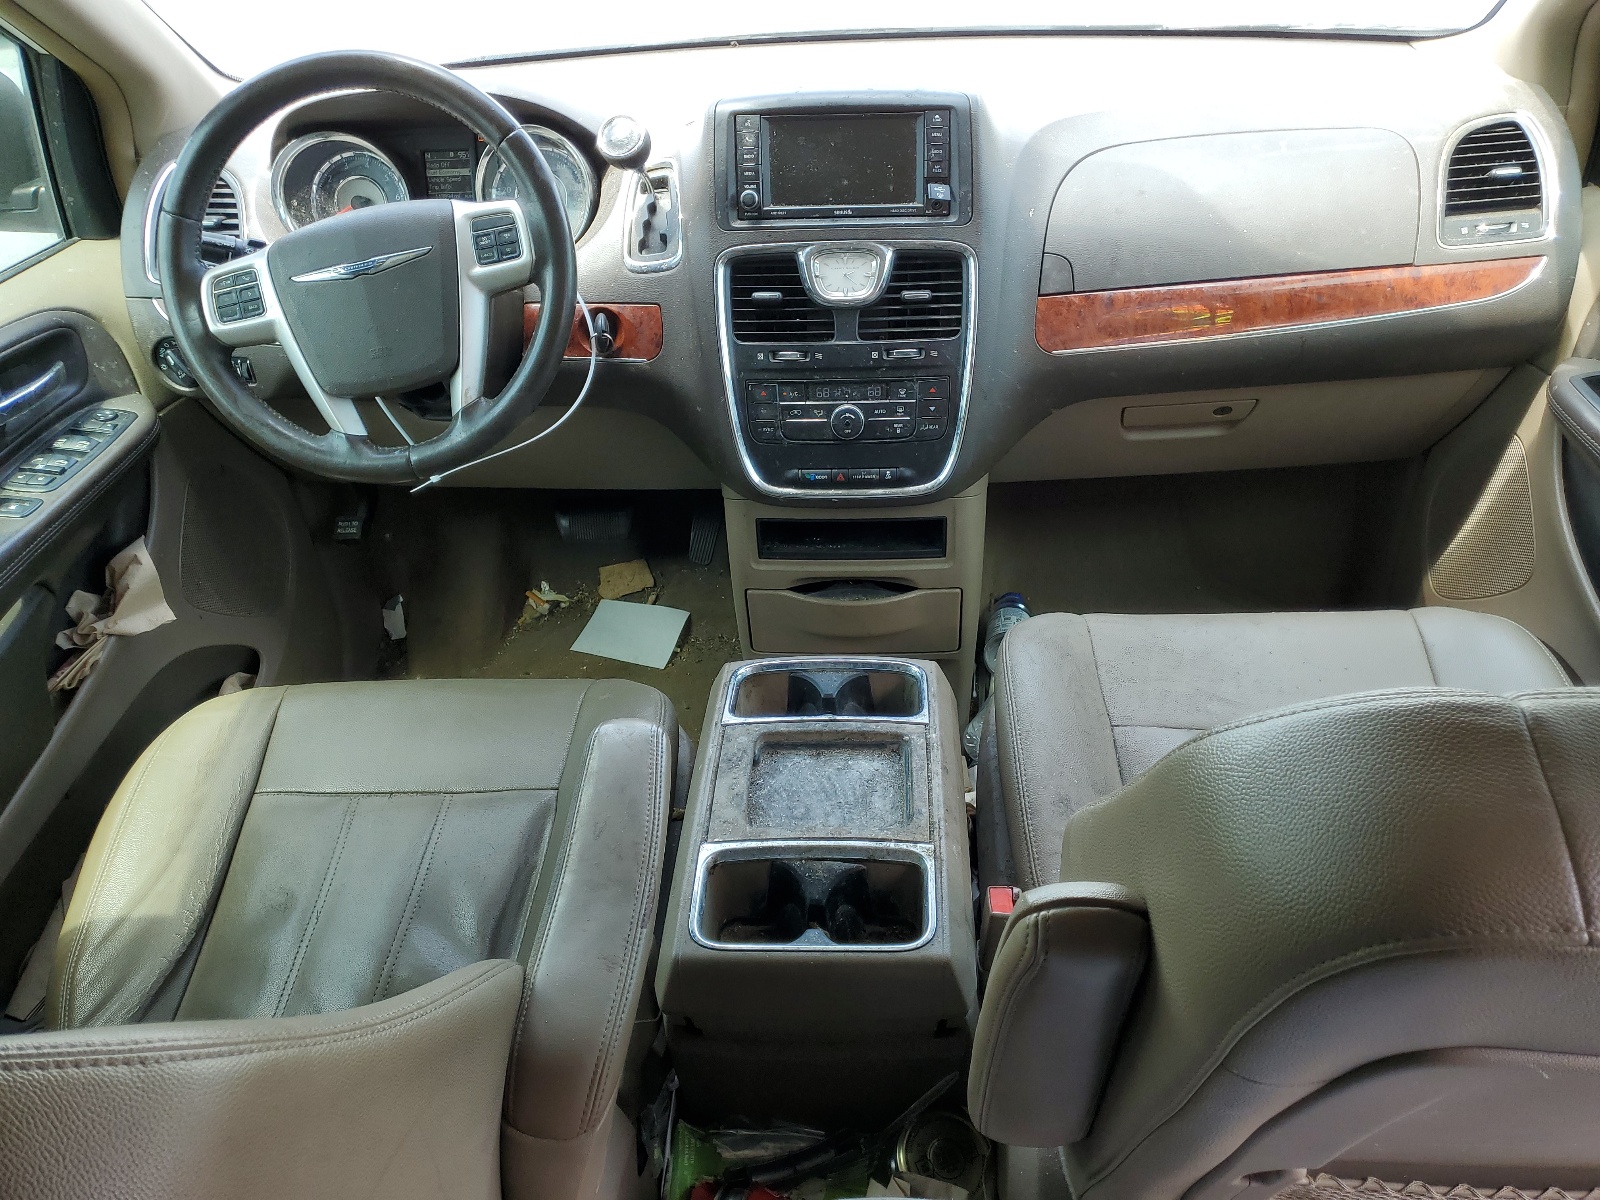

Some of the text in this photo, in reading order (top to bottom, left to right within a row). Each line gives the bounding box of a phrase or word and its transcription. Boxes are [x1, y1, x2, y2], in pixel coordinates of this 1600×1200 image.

[344, 162, 350, 171] 3
[327, 174, 333, 183] 2
[816, 388, 830, 398] 68
